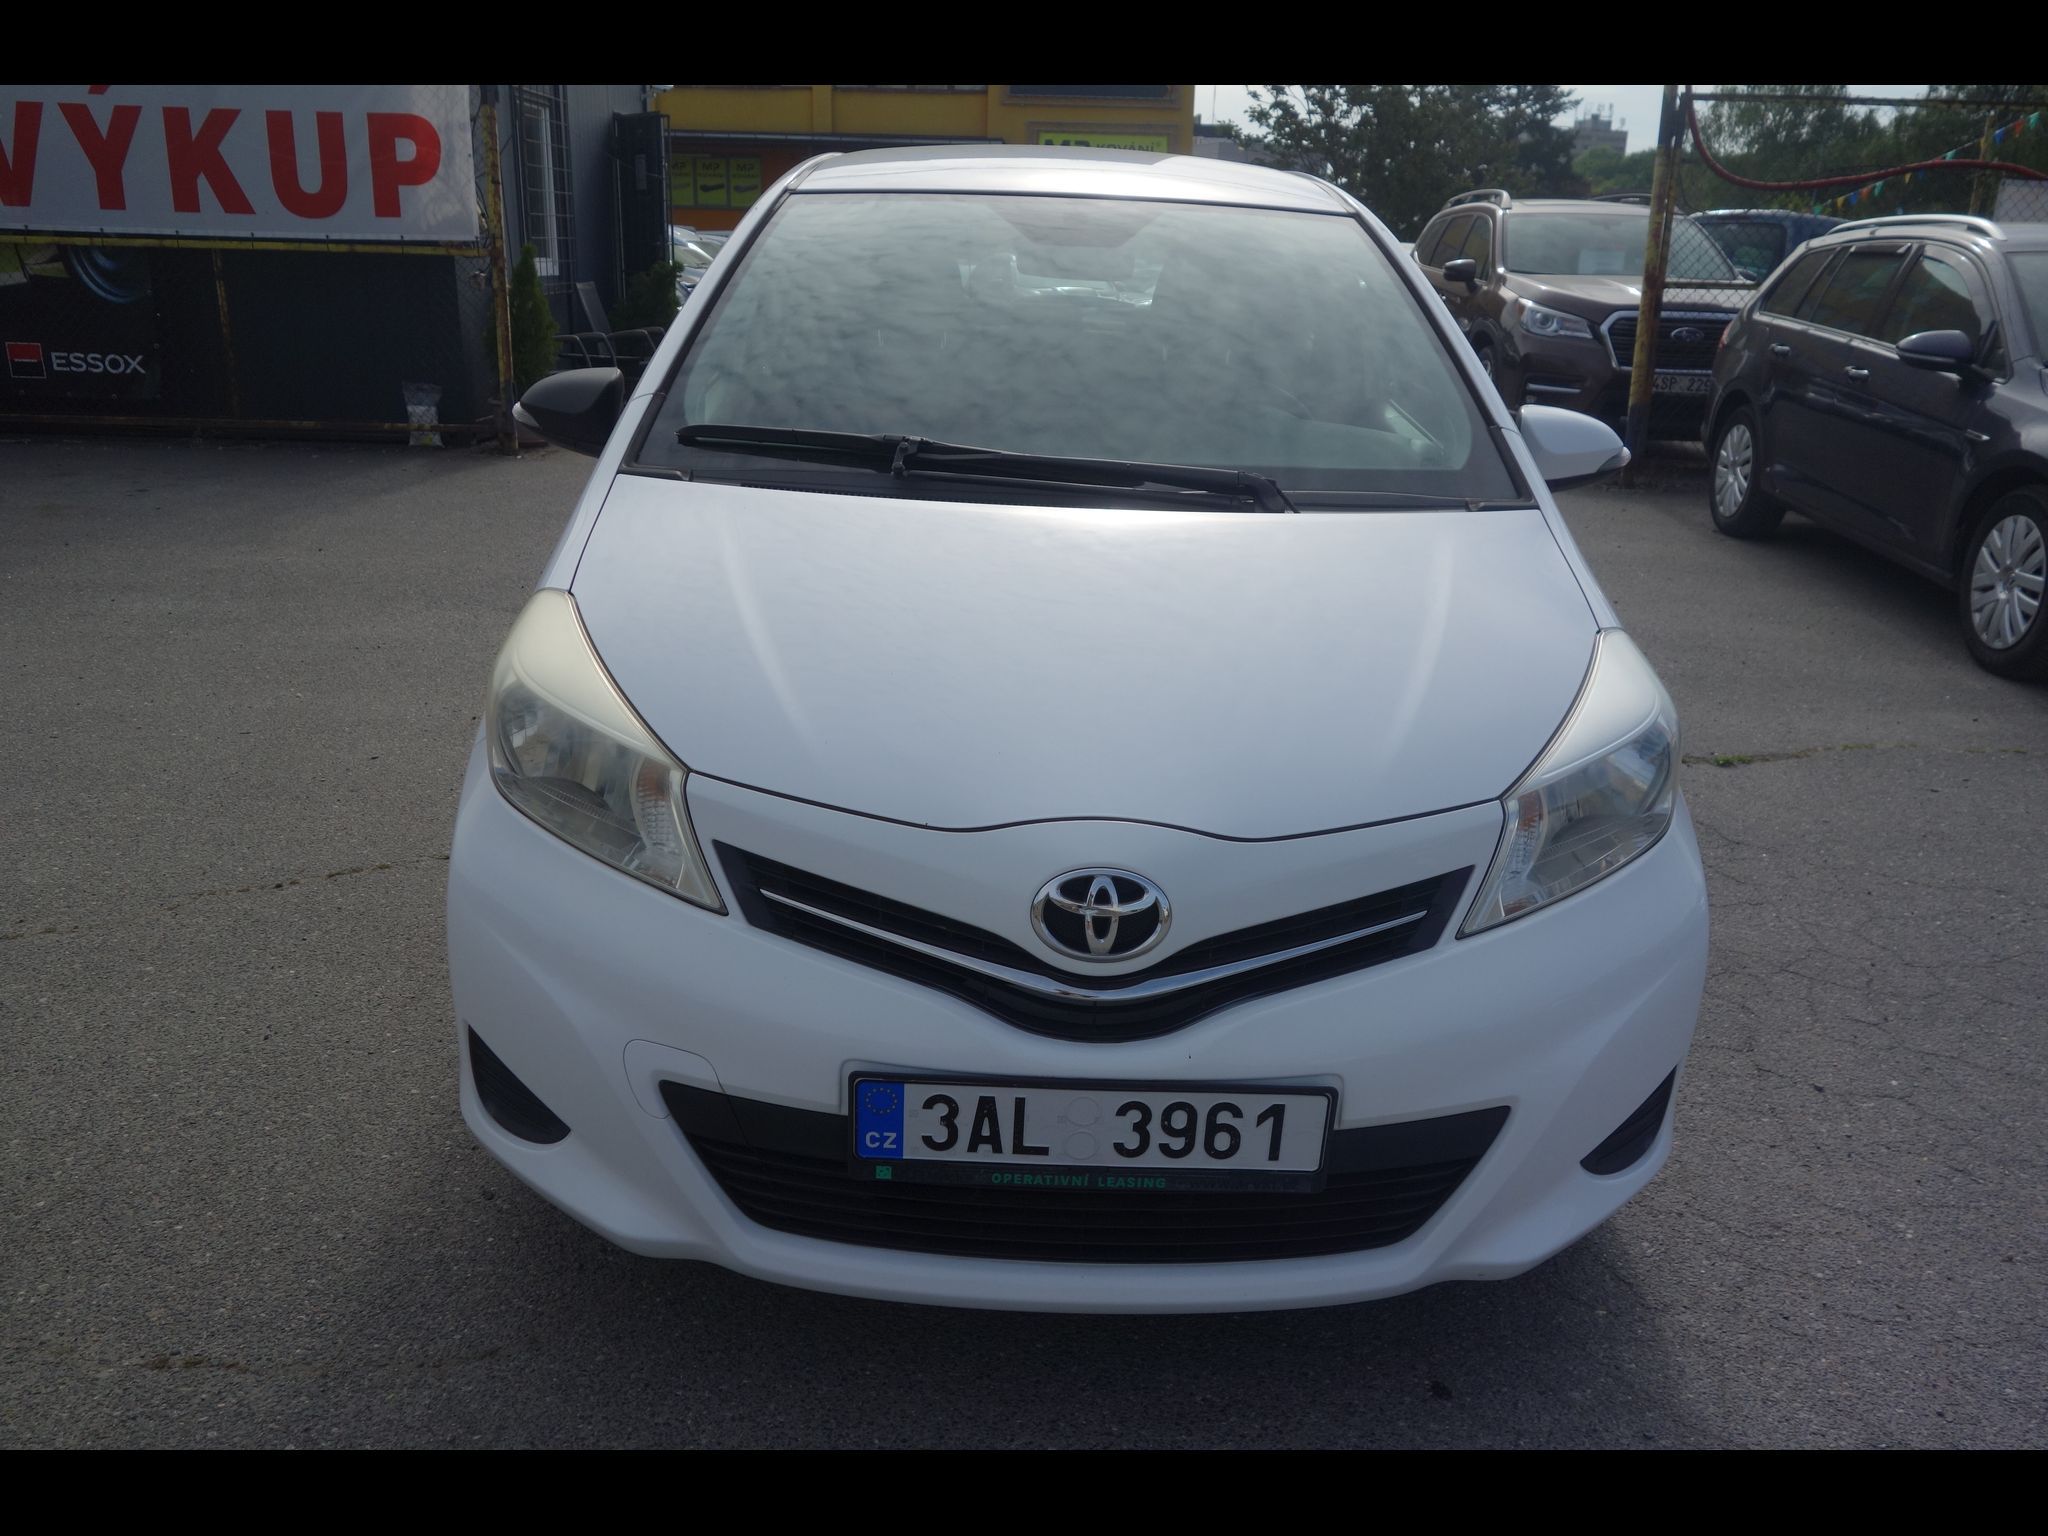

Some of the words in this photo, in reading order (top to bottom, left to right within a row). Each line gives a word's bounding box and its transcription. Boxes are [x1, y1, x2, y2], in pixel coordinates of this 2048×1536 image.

[50, 352, 146, 375] ESSOX
[921, 1093, 1050, 1157] 3AL
[1112, 1100, 1287, 1162] 3961
[865, 1131, 897, 1149] CZ
[991, 1172, 1090, 1187] OPERATIVNÍ
[1098, 1176, 1167, 1190] LEASING
